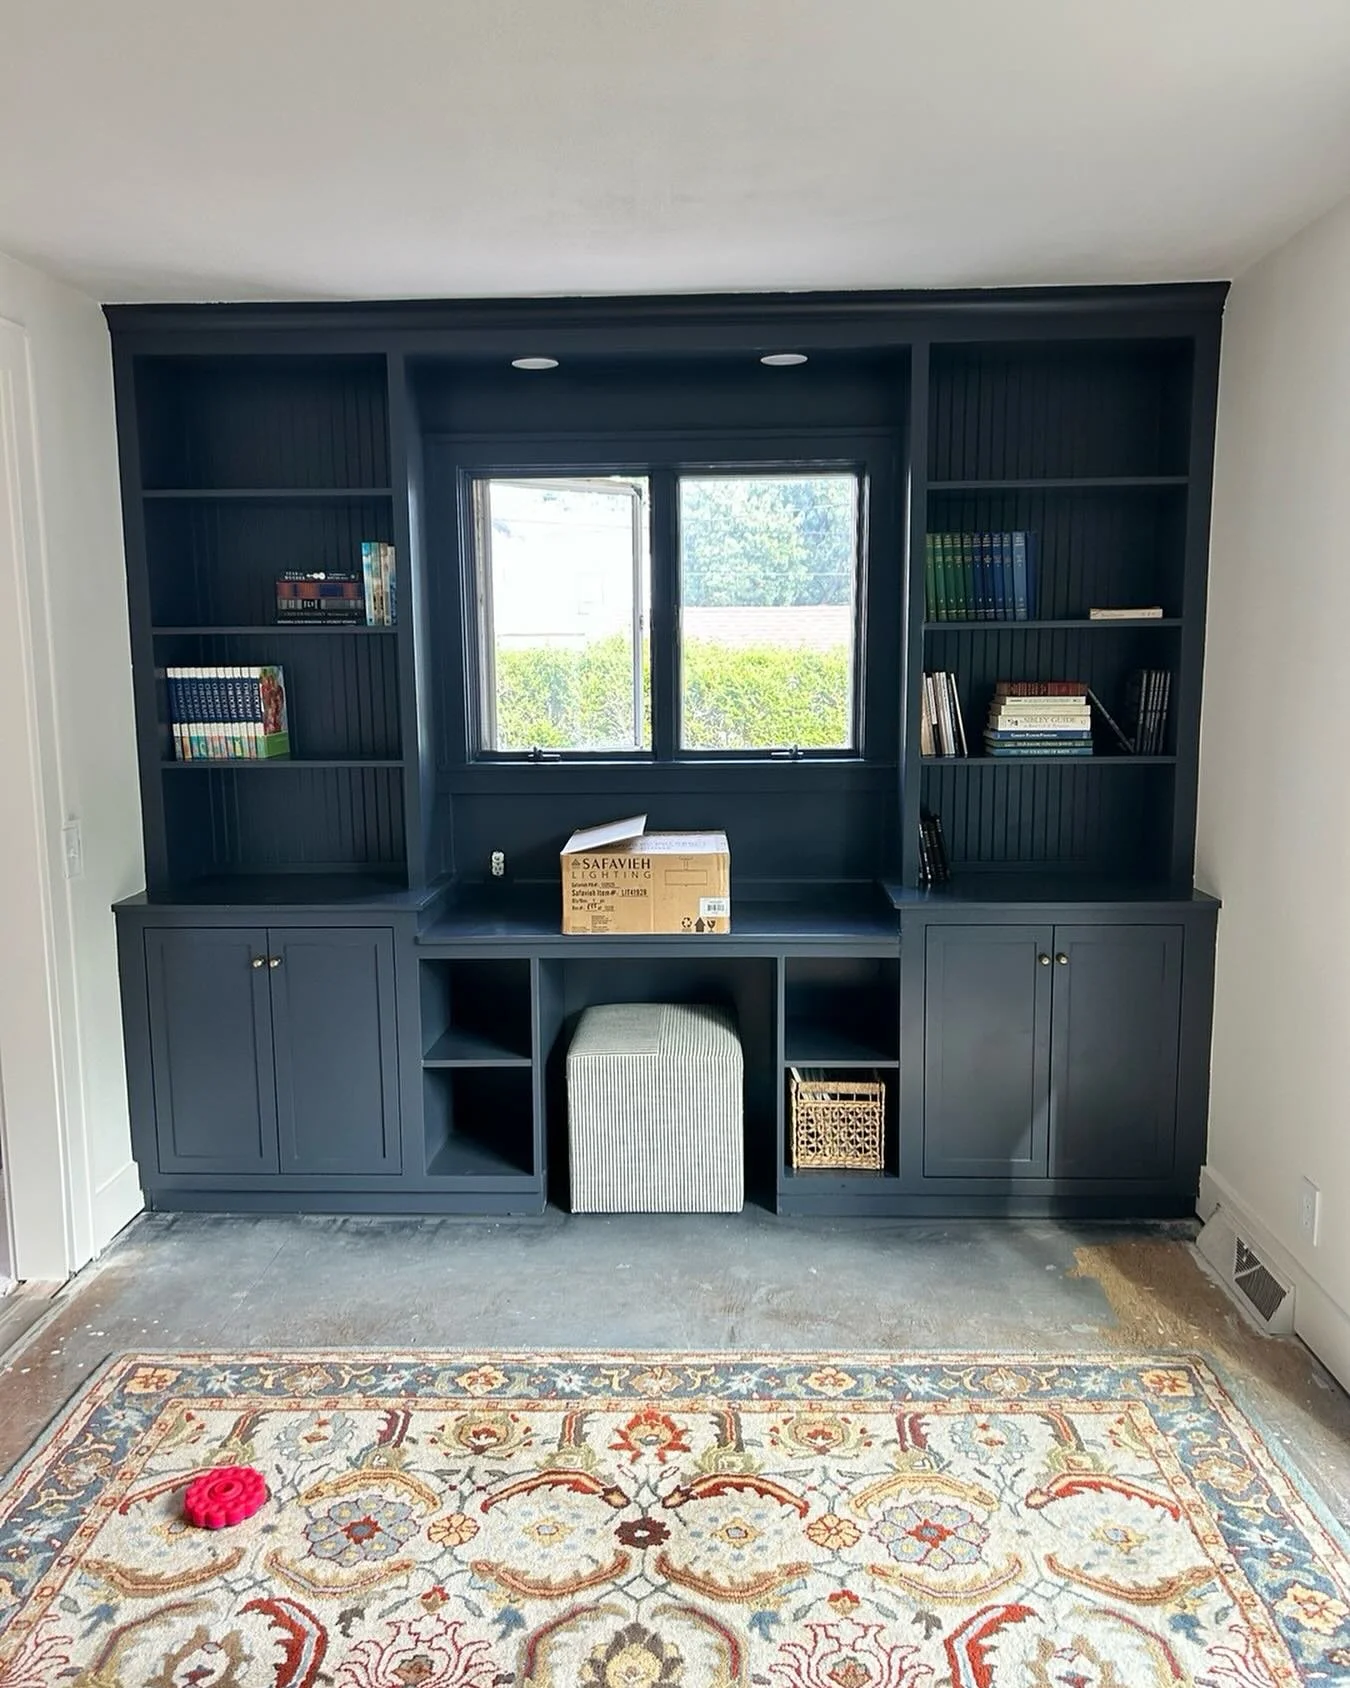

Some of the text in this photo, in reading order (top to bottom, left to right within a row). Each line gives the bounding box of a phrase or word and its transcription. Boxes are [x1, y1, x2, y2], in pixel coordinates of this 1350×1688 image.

[582, 858, 650, 869] SAFAVIEH
[572, 871, 651, 879] LIGHTING
[571, 889, 595, 897] Safavieh
